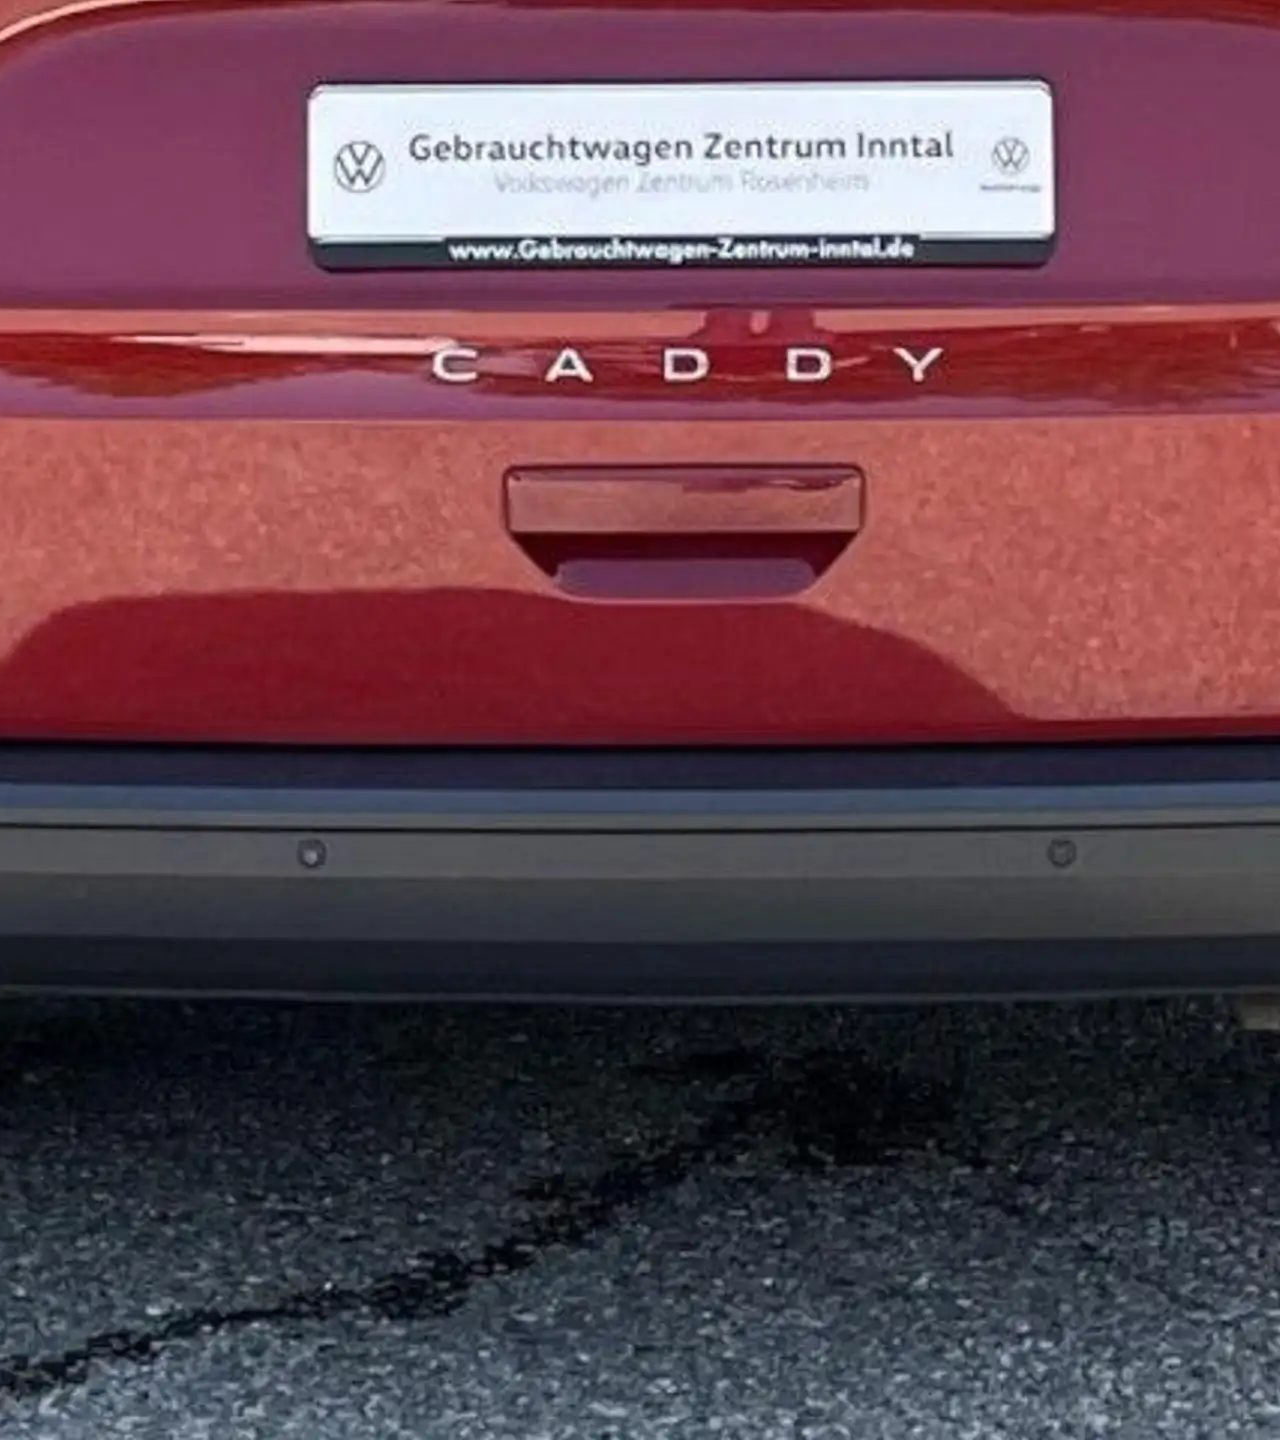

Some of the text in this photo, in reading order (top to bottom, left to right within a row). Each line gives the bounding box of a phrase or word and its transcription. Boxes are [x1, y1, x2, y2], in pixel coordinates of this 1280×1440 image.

[333, 140, 385, 193] VW
[408, 134, 694, 165] Gebrauchtwagen
[703, 132, 847, 161] Zentrum
[856, 130, 954, 158] Inntal
[494, 169, 870, 198] Volkswagen Zentrum Rosenheim
[431, 347, 944, 384] CADDY
